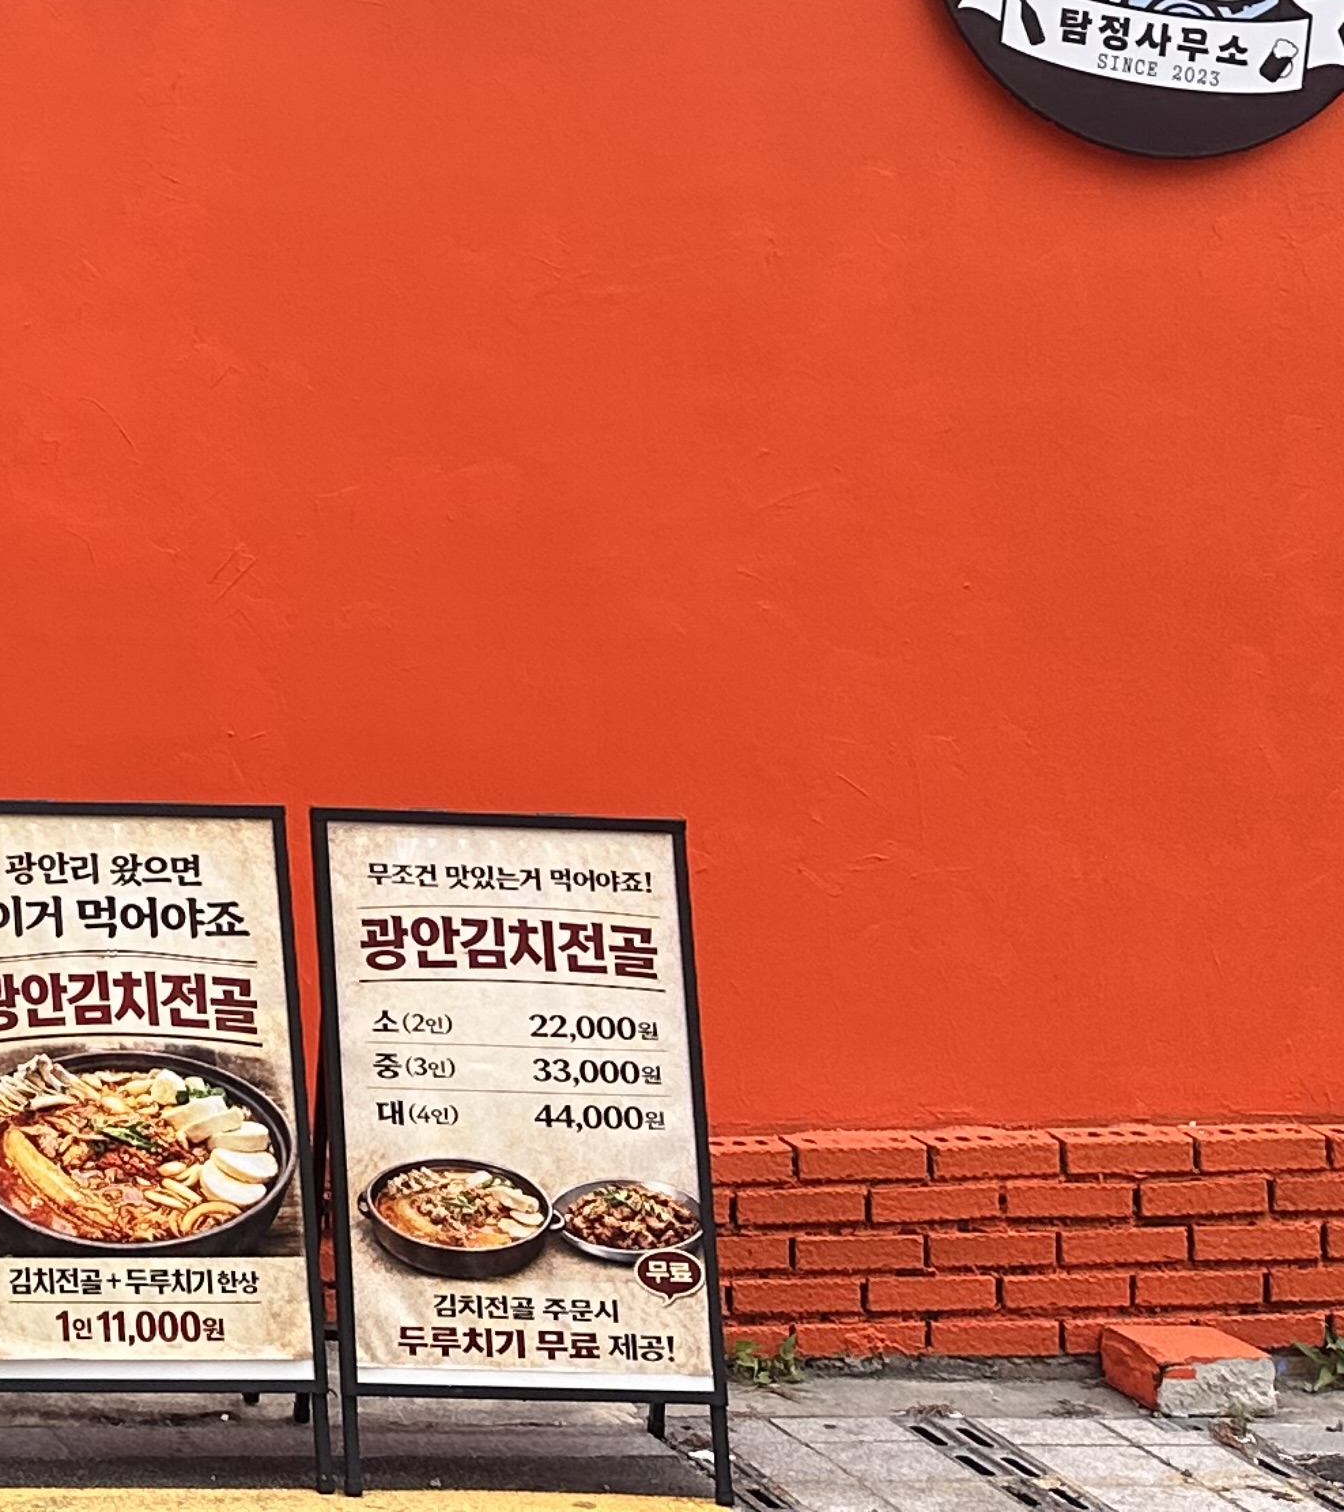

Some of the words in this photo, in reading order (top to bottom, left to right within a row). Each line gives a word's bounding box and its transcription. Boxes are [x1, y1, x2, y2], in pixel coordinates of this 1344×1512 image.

[1059, 8, 1250, 68] 탐정사무소
[1097, 54, 1159, 79] SINCE
[1172, 65, 1222, 87] 2023
[5, 852, 99, 885] 광안리
[110, 853, 203, 887] 왔으면
[367, 863, 439, 888] 무조건
[445, 865, 542, 892] 맛있는거
[549, 868, 653, 894] 먹어야죠!
[76, 897, 251, 939] 먹어야죠
[360, 915, 658, 980] 광안김치전골
[372, 1010, 453, 1035] 소(2인)
[528, 1014, 659, 1042] 22,000원
[372, 1053, 456, 1079] 중(3인)
[532, 1058, 662, 1087] 33,000원
[377, 1100, 459, 1127] 대(4인)
[534, 1104, 666, 1132] 44,000원
[217, 1271, 259, 1295] 한상
[645, 1261, 694, 1284] 무료
[433, 1293, 535, 1321] 김치전골
[542, 1298, 619, 1323] 주문시
[55, 1311, 92, 1343] 1인
[97, 1310, 226, 1347] 11,000원
[398, 1327, 526, 1359] 두루치기
[535, 1330, 600, 1360] 무료
[608, 1334, 675, 1363] 제공!
